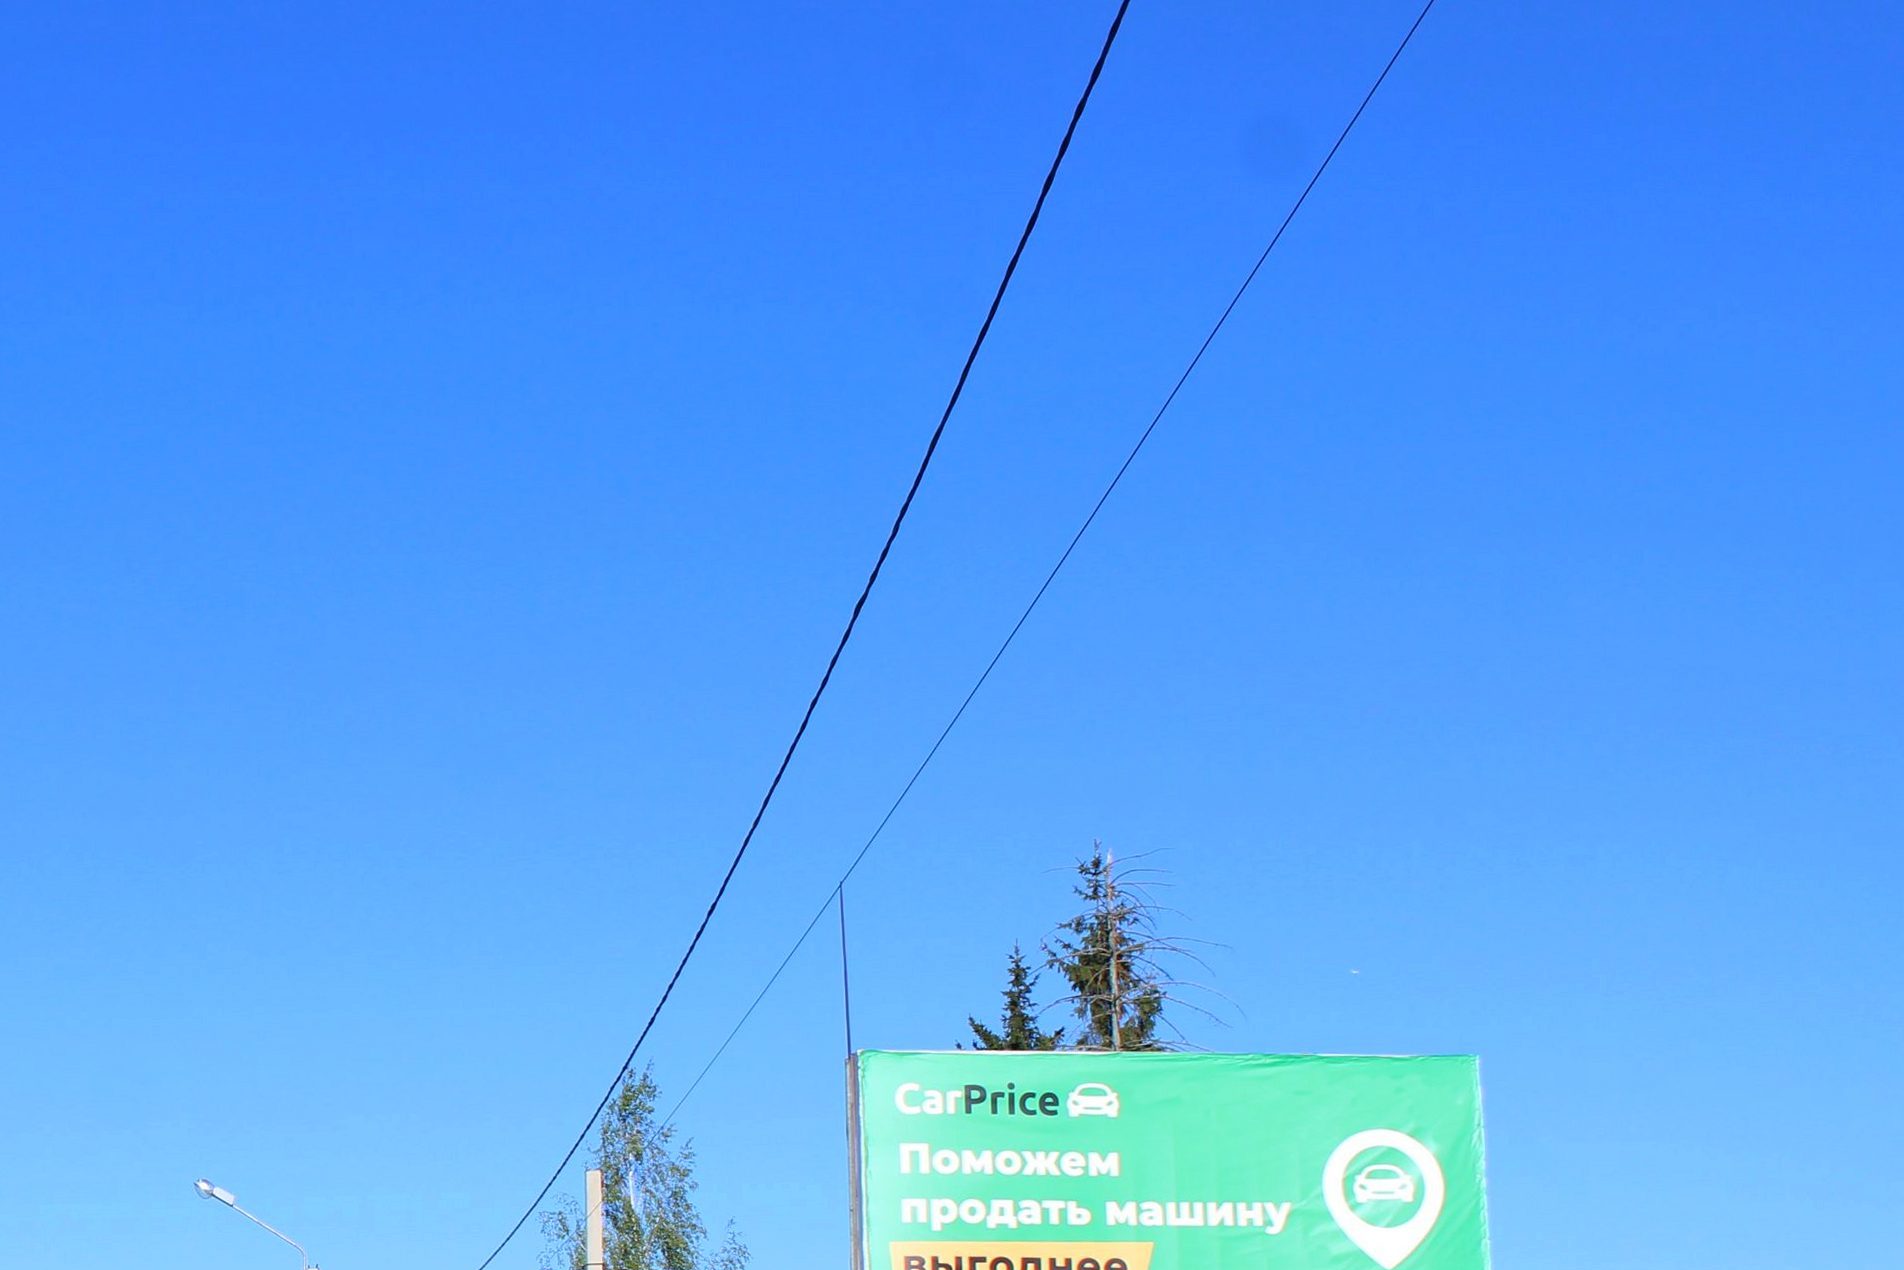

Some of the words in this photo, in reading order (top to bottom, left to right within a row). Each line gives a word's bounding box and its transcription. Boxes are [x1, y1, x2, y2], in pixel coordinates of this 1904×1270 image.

[894, 1082, 1060, 1116] CarPrice
[899, 1143, 1120, 1177] Поможем
[900, 1198, 1092, 1231] продать
[1105, 1201, 1292, 1235] машину
